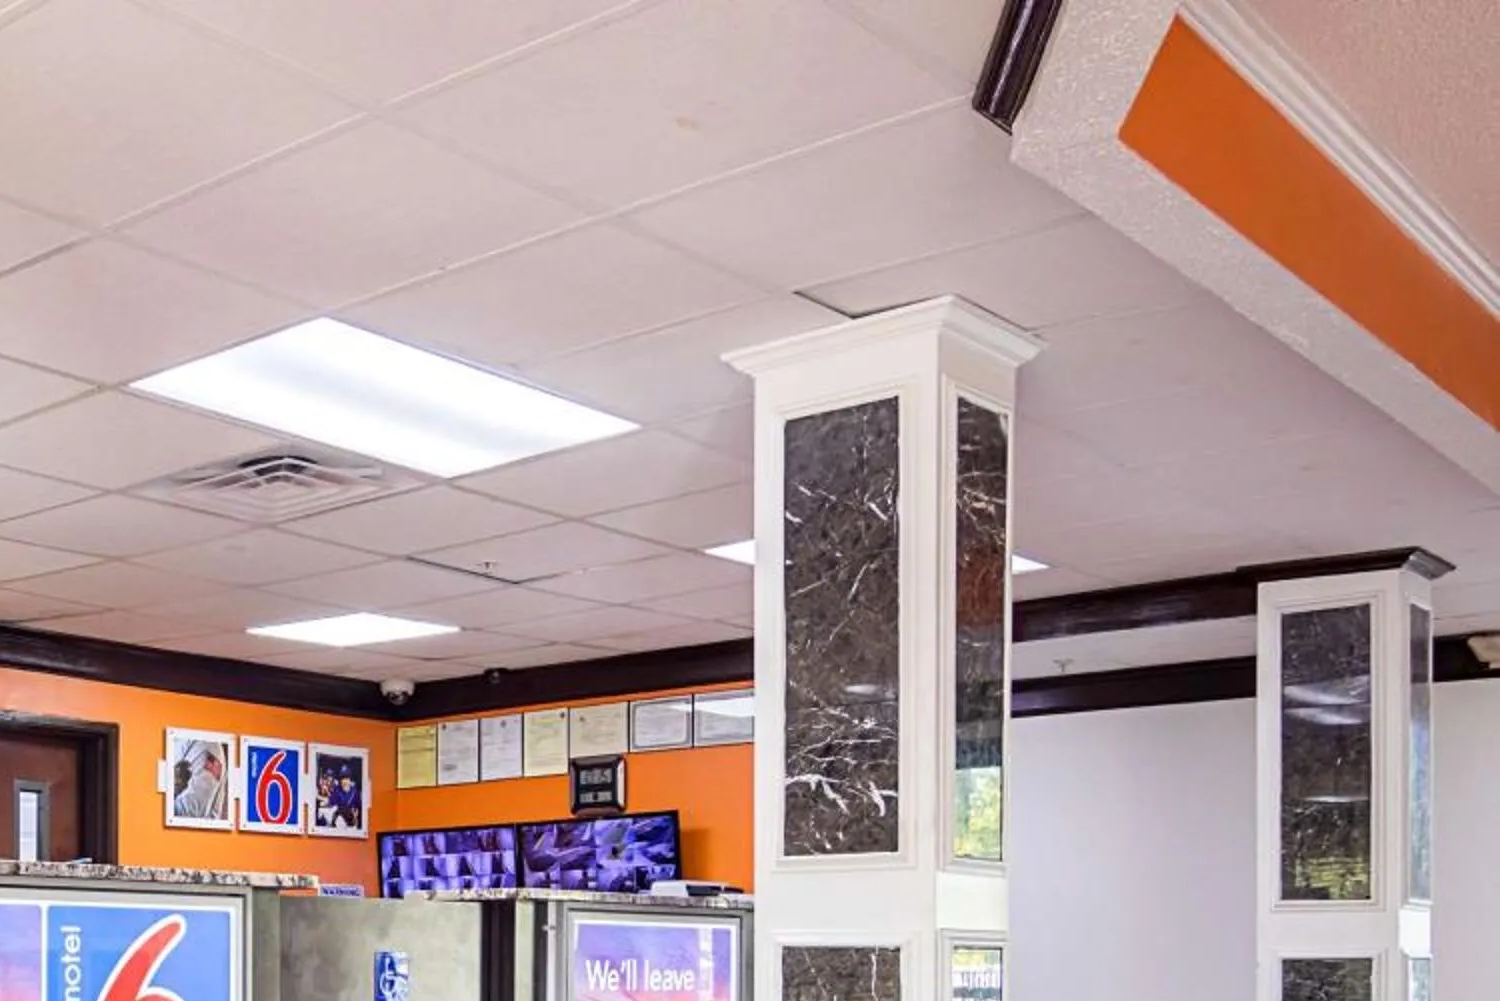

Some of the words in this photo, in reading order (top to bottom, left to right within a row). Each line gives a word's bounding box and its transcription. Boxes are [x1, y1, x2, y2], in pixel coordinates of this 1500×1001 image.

[255, 751, 293, 825] 6
[585, 959, 638, 992] We'll
[644, 959, 696, 992] leave
